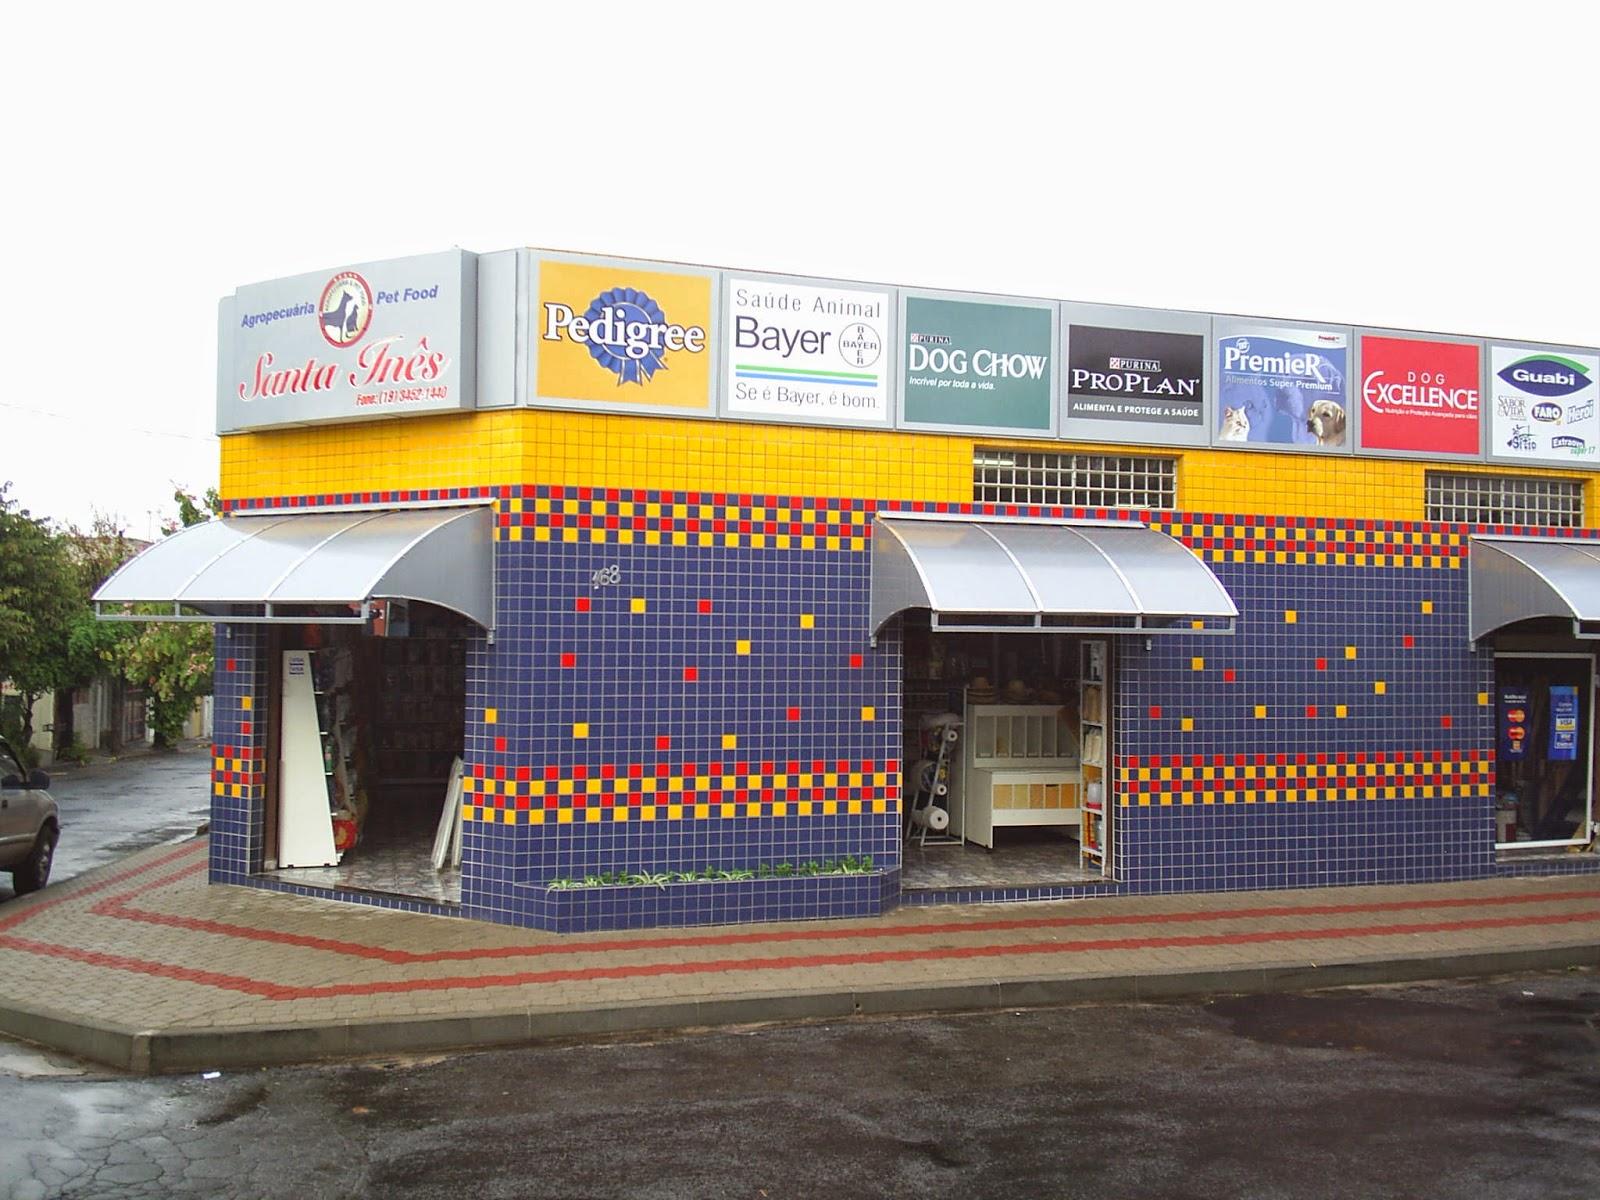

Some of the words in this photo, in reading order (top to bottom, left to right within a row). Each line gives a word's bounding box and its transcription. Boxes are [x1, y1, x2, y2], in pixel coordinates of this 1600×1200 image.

[377, 291, 399, 304] Pet
[403, 285, 438, 302] Food
[736, 288, 801, 311] Saúde
[813, 296, 880, 318] Animal
[241, 302, 315, 328] Agropecuária
[542, 302, 706, 359] Pedigree
[735, 315, 831, 358] Bayer
[843, 340, 877, 350] BAYER
[919, 335, 950, 344] PURINA
[239, 352, 338, 400] Santa
[350, 335, 445, 387] Inês
[909, 344, 968, 375] DOG
[972, 349, 1048, 380] CHOW
[1120, 360, 1158, 371] PURINA
[909, 376, 938, 386] Incrível
[938, 380, 951, 388] por
[952, 379, 969, 388] toda
[1226, 375, 1267, 386] Alimentos
[1269, 377, 1293, 389] Super
[1296, 380, 1333, 391] Premium
[1407, 371, 1446, 385] DOG
[1512, 369, 1575, 386] Guabi
[736, 382, 757, 400] Se
[762, 386, 771, 401] é
[777, 386, 824, 406] Bayer,
[829, 390, 838, 405] é
[842, 392, 880, 408] bom.
[1363, 371, 1478, 413] EXCELLENCE
[1073, 403, 1115, 413] ALIMENTA
[1117, 405, 1123, 413] E
[1124, 406, 1162, 415] PROTEGE
[1171, 406, 1199, 417] SAÚDE
[1498, 395, 1526, 408] SABOR
[1534, 406, 1560, 420] FARO
